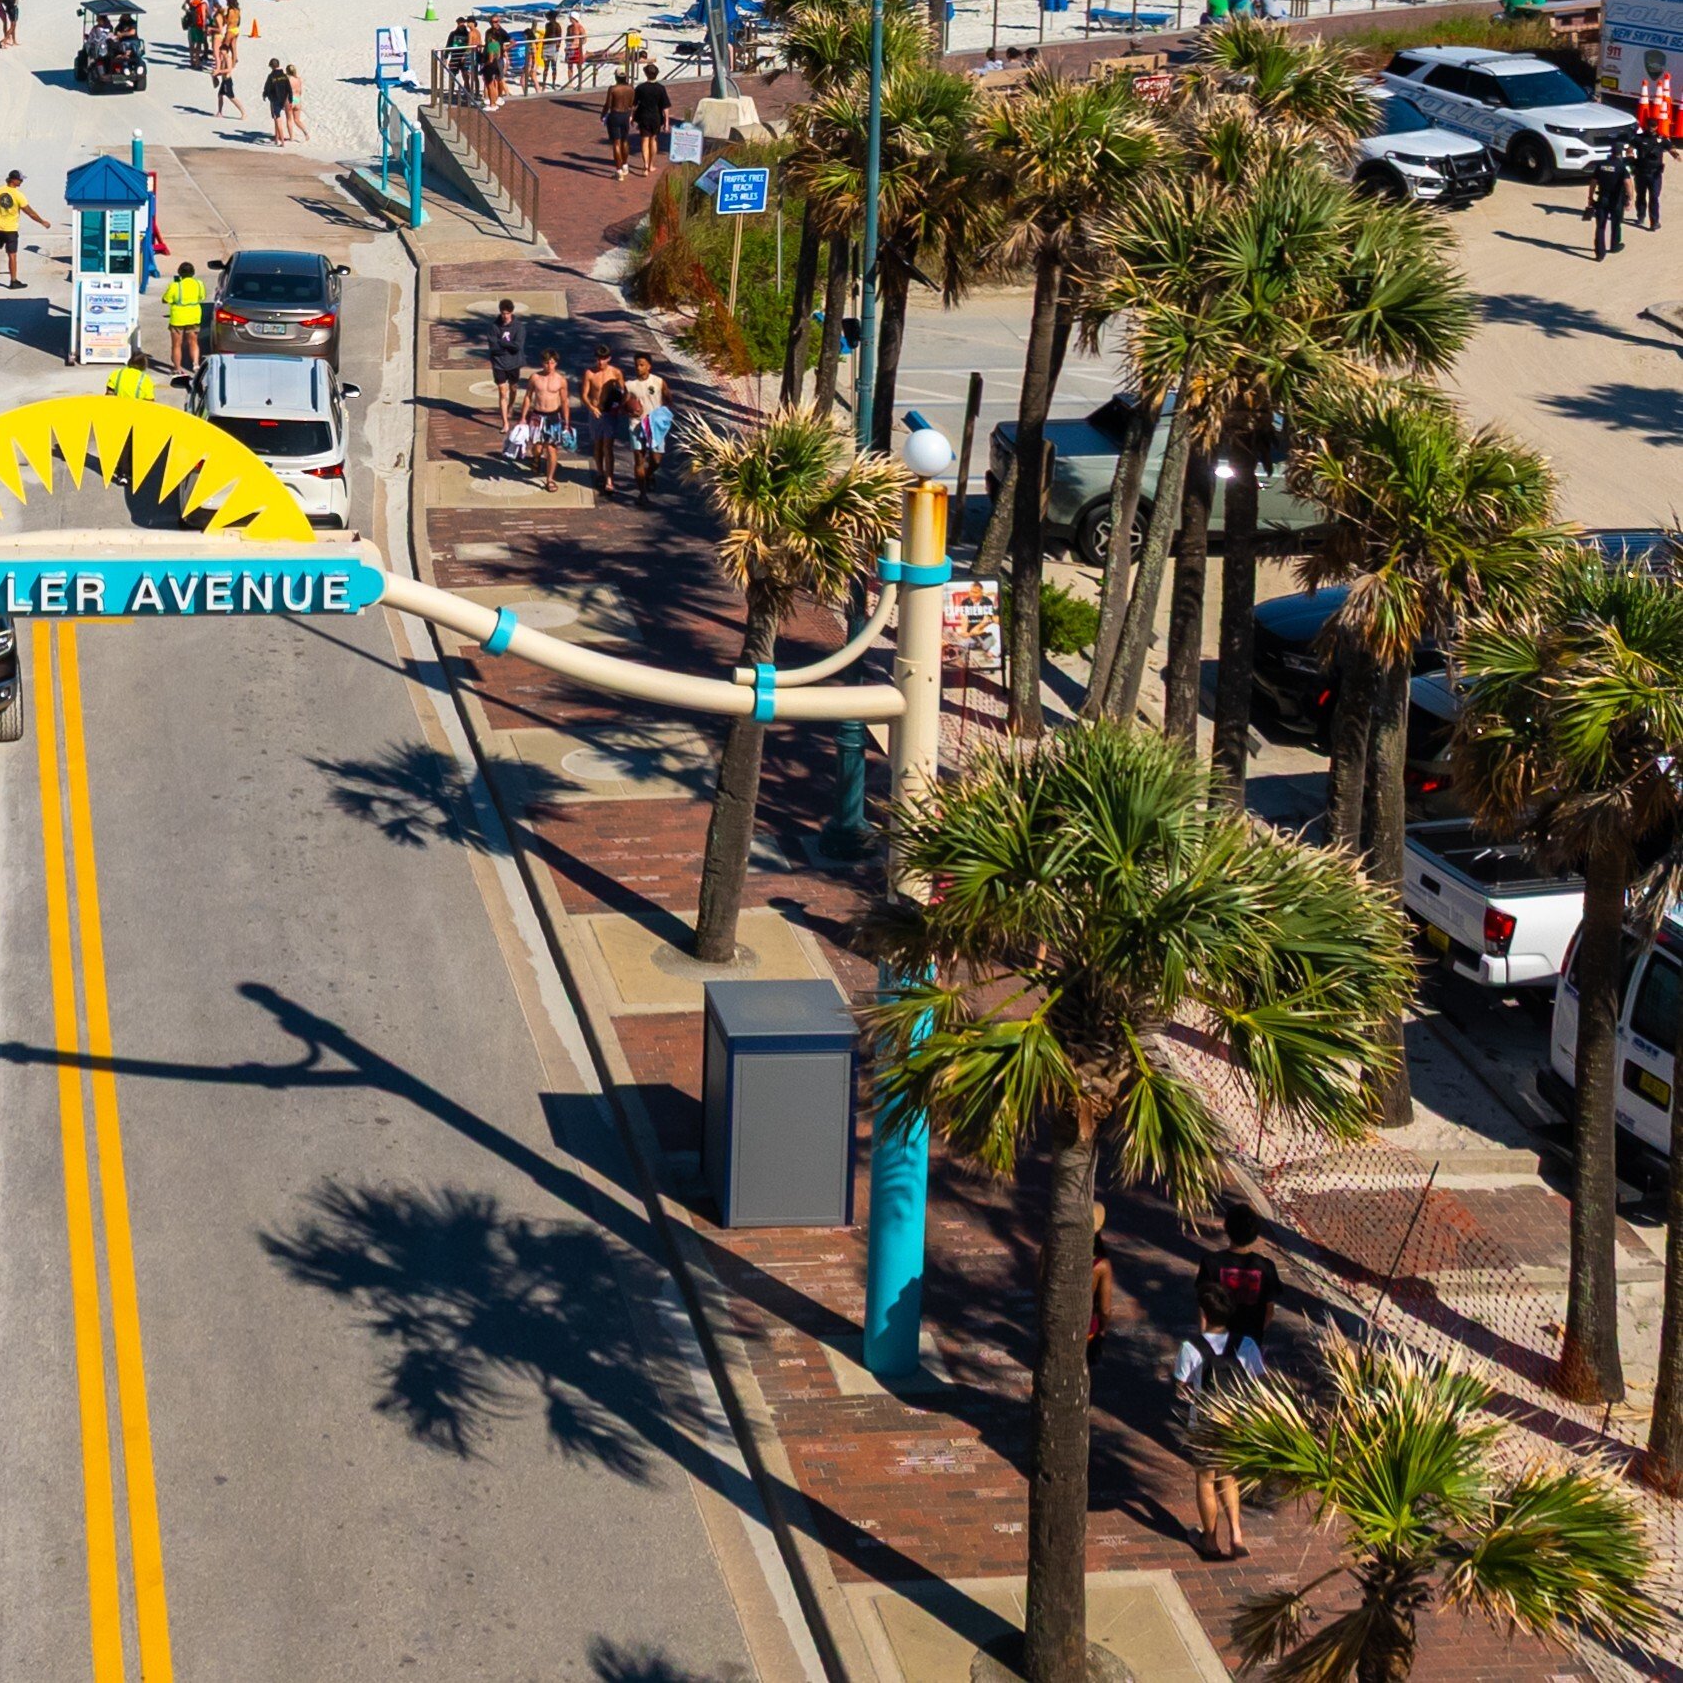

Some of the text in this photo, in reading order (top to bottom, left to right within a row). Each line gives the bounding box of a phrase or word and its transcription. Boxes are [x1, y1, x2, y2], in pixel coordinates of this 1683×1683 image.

[1612, 27, 1631, 40] NEW
[1633, 31, 1668, 46] SMYRNA
[1606, 45, 1622, 57] 911
[723, 174, 765, 182] TRAFFIC FREE
[732, 183, 754, 191] BEACH
[724, 193, 738, 202] 2.25
[131, 572, 352, 611] AVENUE
